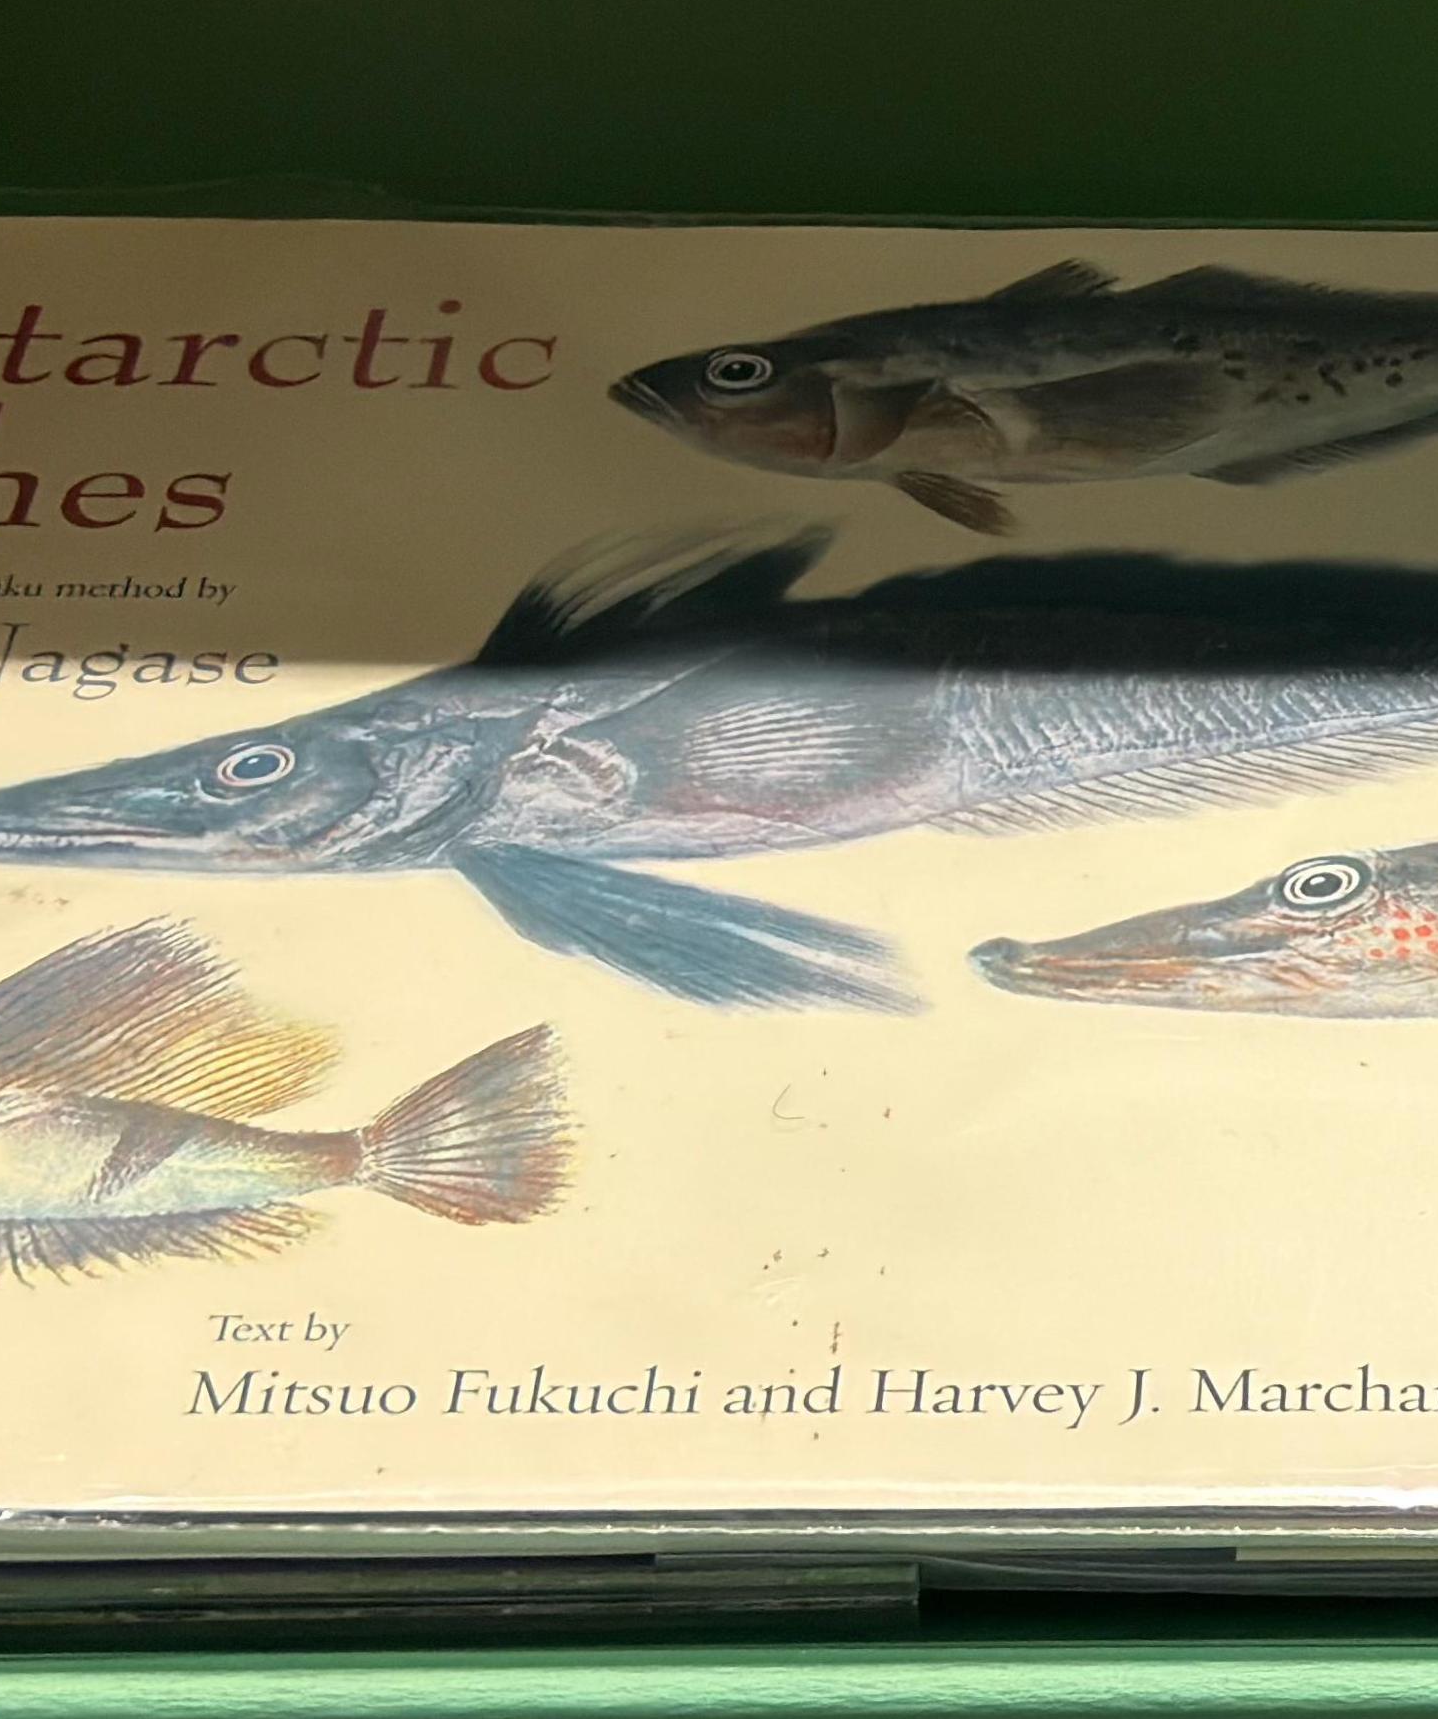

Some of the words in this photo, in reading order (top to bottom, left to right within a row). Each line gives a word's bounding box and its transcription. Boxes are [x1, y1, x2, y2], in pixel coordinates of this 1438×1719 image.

[56, 576, 188, 599] method
[197, 576, 237, 605] by
[207, 1310, 293, 1347] Text
[300, 1310, 352, 1351] by
[182, 1367, 420, 1421] Mitsuo
[441, 1365, 706, 1419] Fukuchi
[721, 1365, 844, 1419] and
[864, 1367, 1107, 1433] Harvey
[1116, 1367, 1163, 1430] J.
